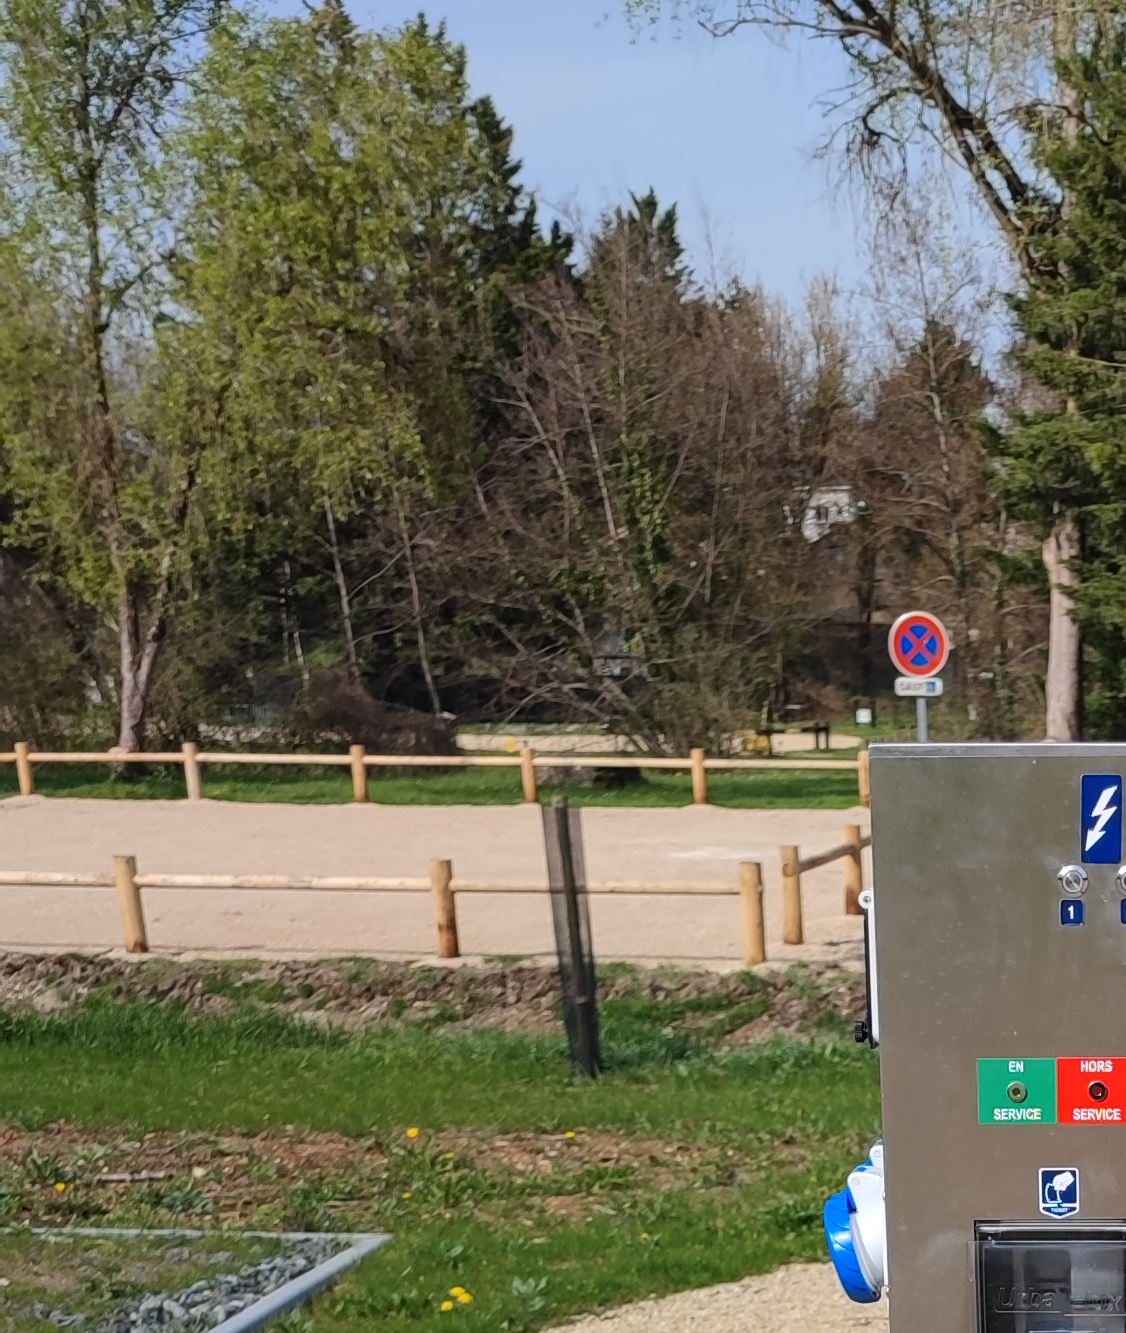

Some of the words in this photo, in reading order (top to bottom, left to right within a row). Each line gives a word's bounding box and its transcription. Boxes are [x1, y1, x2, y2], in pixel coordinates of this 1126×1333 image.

[1067, 905, 1075, 919] 1
[1009, 1061, 1024, 1072] EN
[1080, 1060, 1113, 1073] HORS
[993, 1108, 1042, 1120] SERVICE
[1073, 1108, 1122, 1120] SERVICE
